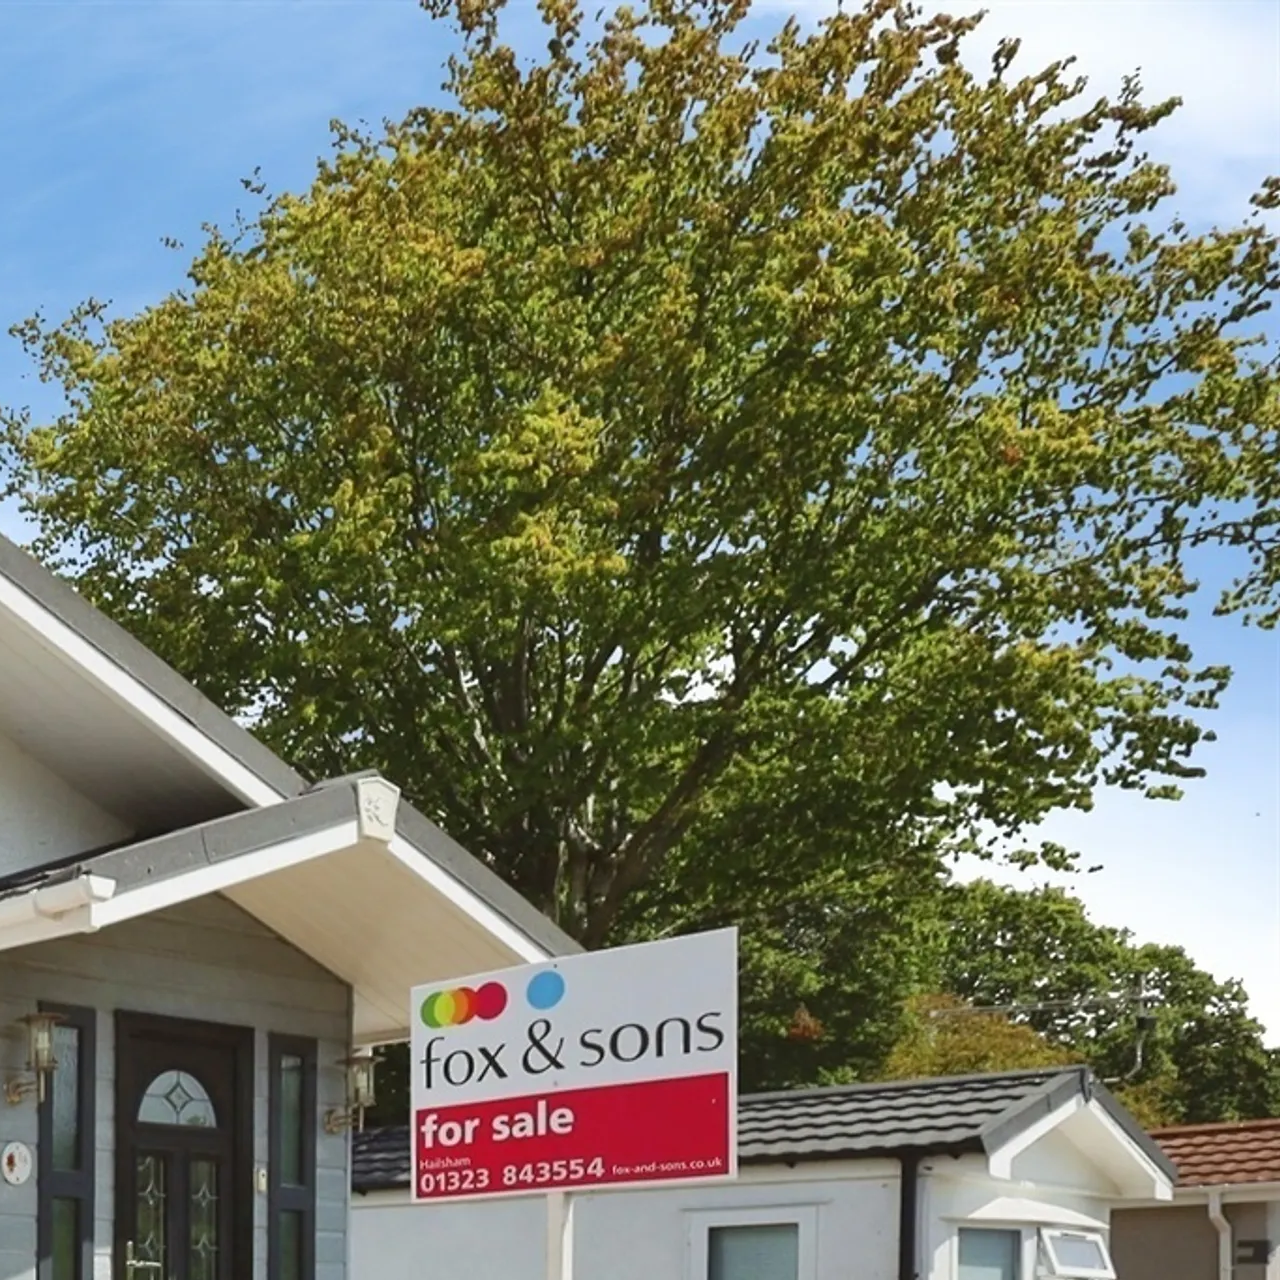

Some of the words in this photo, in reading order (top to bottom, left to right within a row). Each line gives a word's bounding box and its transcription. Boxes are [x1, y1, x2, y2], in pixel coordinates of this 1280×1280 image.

[420, 1036, 508, 1089] fox
[522, 1018, 566, 1075] &
[579, 1012, 725, 1067] sons
[420, 1114, 480, 1149] for
[491, 1100, 575, 1141] sale
[419, 1156, 471, 1171] Hailsham
[420, 1168, 490, 1193] 01323
[502, 1157, 605, 1186] 843554
[612, 1157, 723, 1176] fox-and-sons.co.uk
